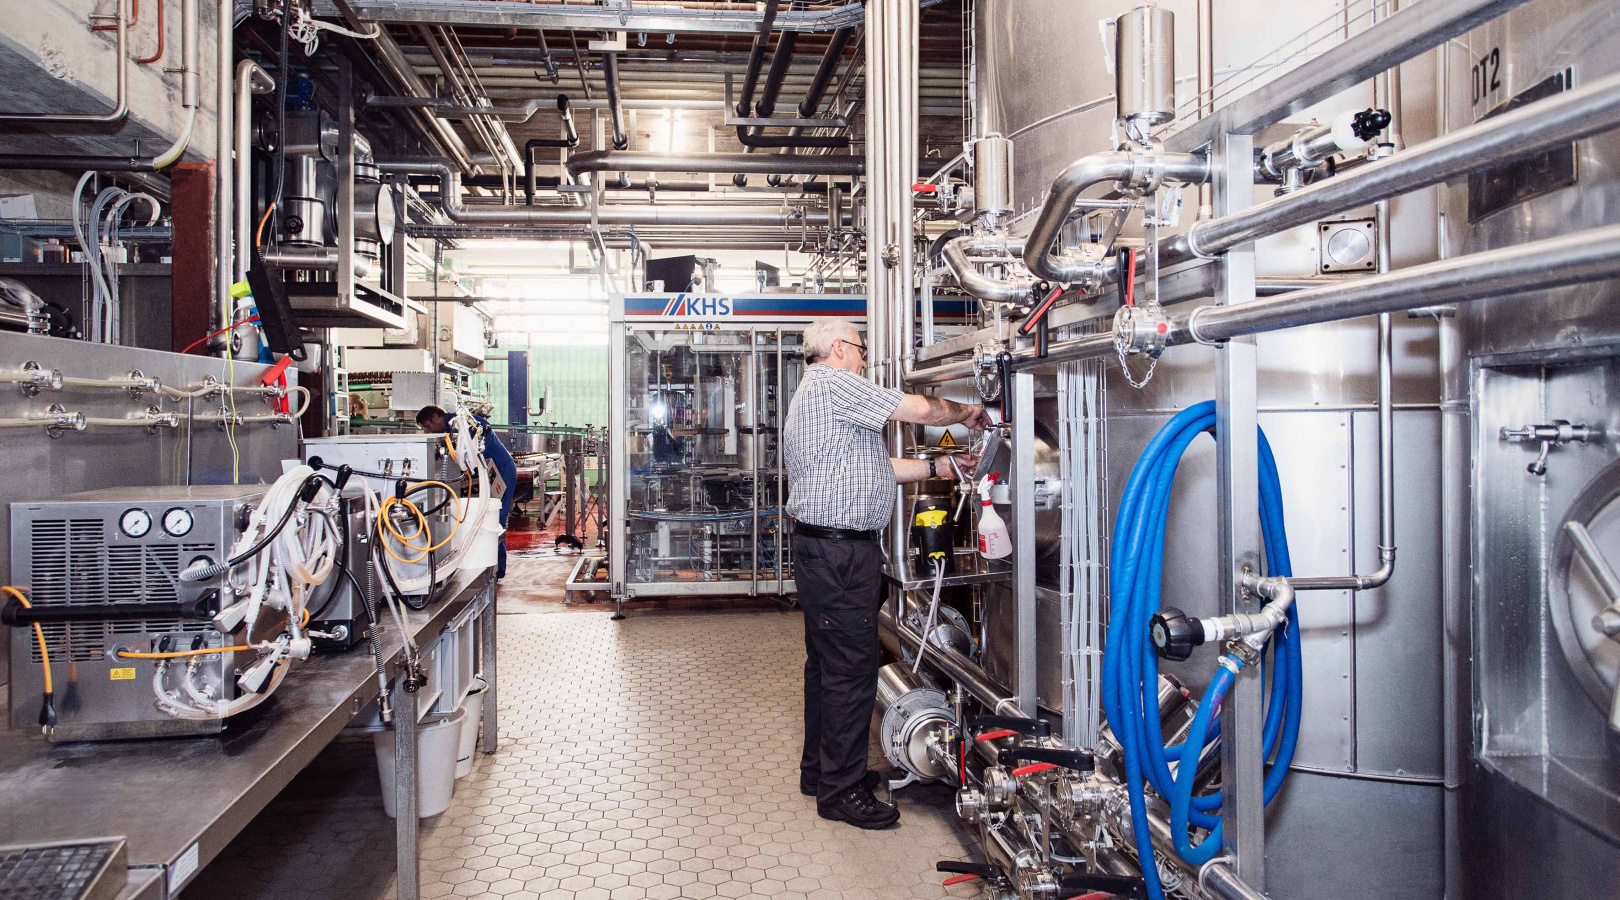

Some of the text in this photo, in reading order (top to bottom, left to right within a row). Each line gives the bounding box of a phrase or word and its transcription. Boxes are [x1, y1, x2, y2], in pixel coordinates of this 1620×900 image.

[1472, 47, 1500, 106] DT2
[687, 297, 730, 316] KHS
[113, 532, 119, 540] 1
[158, 532, 166, 540] 2
